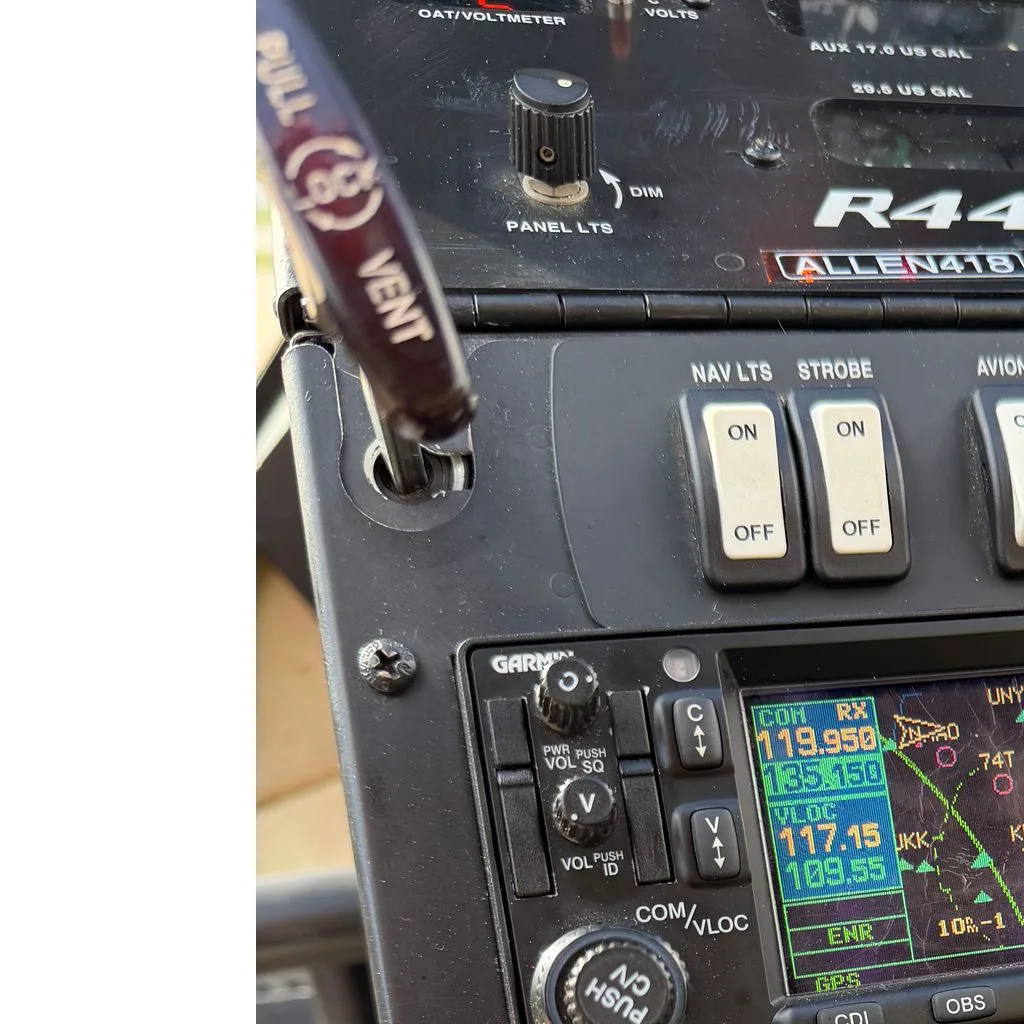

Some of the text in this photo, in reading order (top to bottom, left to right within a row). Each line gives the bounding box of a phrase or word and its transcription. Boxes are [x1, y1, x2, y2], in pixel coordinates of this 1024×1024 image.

[418, 8, 567, 26] OAT/VOLTMETER
[643, 8, 699, 20] VOLTS
[810, 40, 972, 60] AUX 17.0 US GAL
[896, 84, 926, 97] US
[930, 86, 973, 99] GAL
[629, 186, 664, 198] DIM
[506, 220, 614, 234] PANEL LTS
[796, 255, 1016, 276] ALLEN418
[358, 247, 435, 344] VENT
[691, 361, 773, 383] NAV LTS
[797, 358, 874, 381] STROBE
[728, 423, 758, 440] ON
[836, 421, 866, 437] ON
[734, 524, 774, 541] OFF
[842, 519, 881, 536] OFF
[687, 703, 704, 722] C
[758, 702, 868, 727] COM RX
[543, 744, 571, 756] PWR
[757, 725, 878, 760] 119.950
[576, 748, 607, 760] PUSH
[978, 751, 1015, 770] 74T
[544, 757, 577, 771] VOL
[582, 760, 605, 774] SQ
[762, 760, 883, 794] 135.150
[774, 803, 838, 825] VLOC
[705, 816, 720, 834] V
[780, 822, 882, 857] 117.15
[561, 856, 593, 871] VOL
[593, 850, 625, 863] PUSH
[603, 862, 619, 877] ID
[785, 856, 887, 890] 109.55
[827, 923, 875, 945] ENR
[609, 963, 651, 997] C/V
[815, 972, 862, 993] GPS
[946, 994, 986, 1015] OBS
